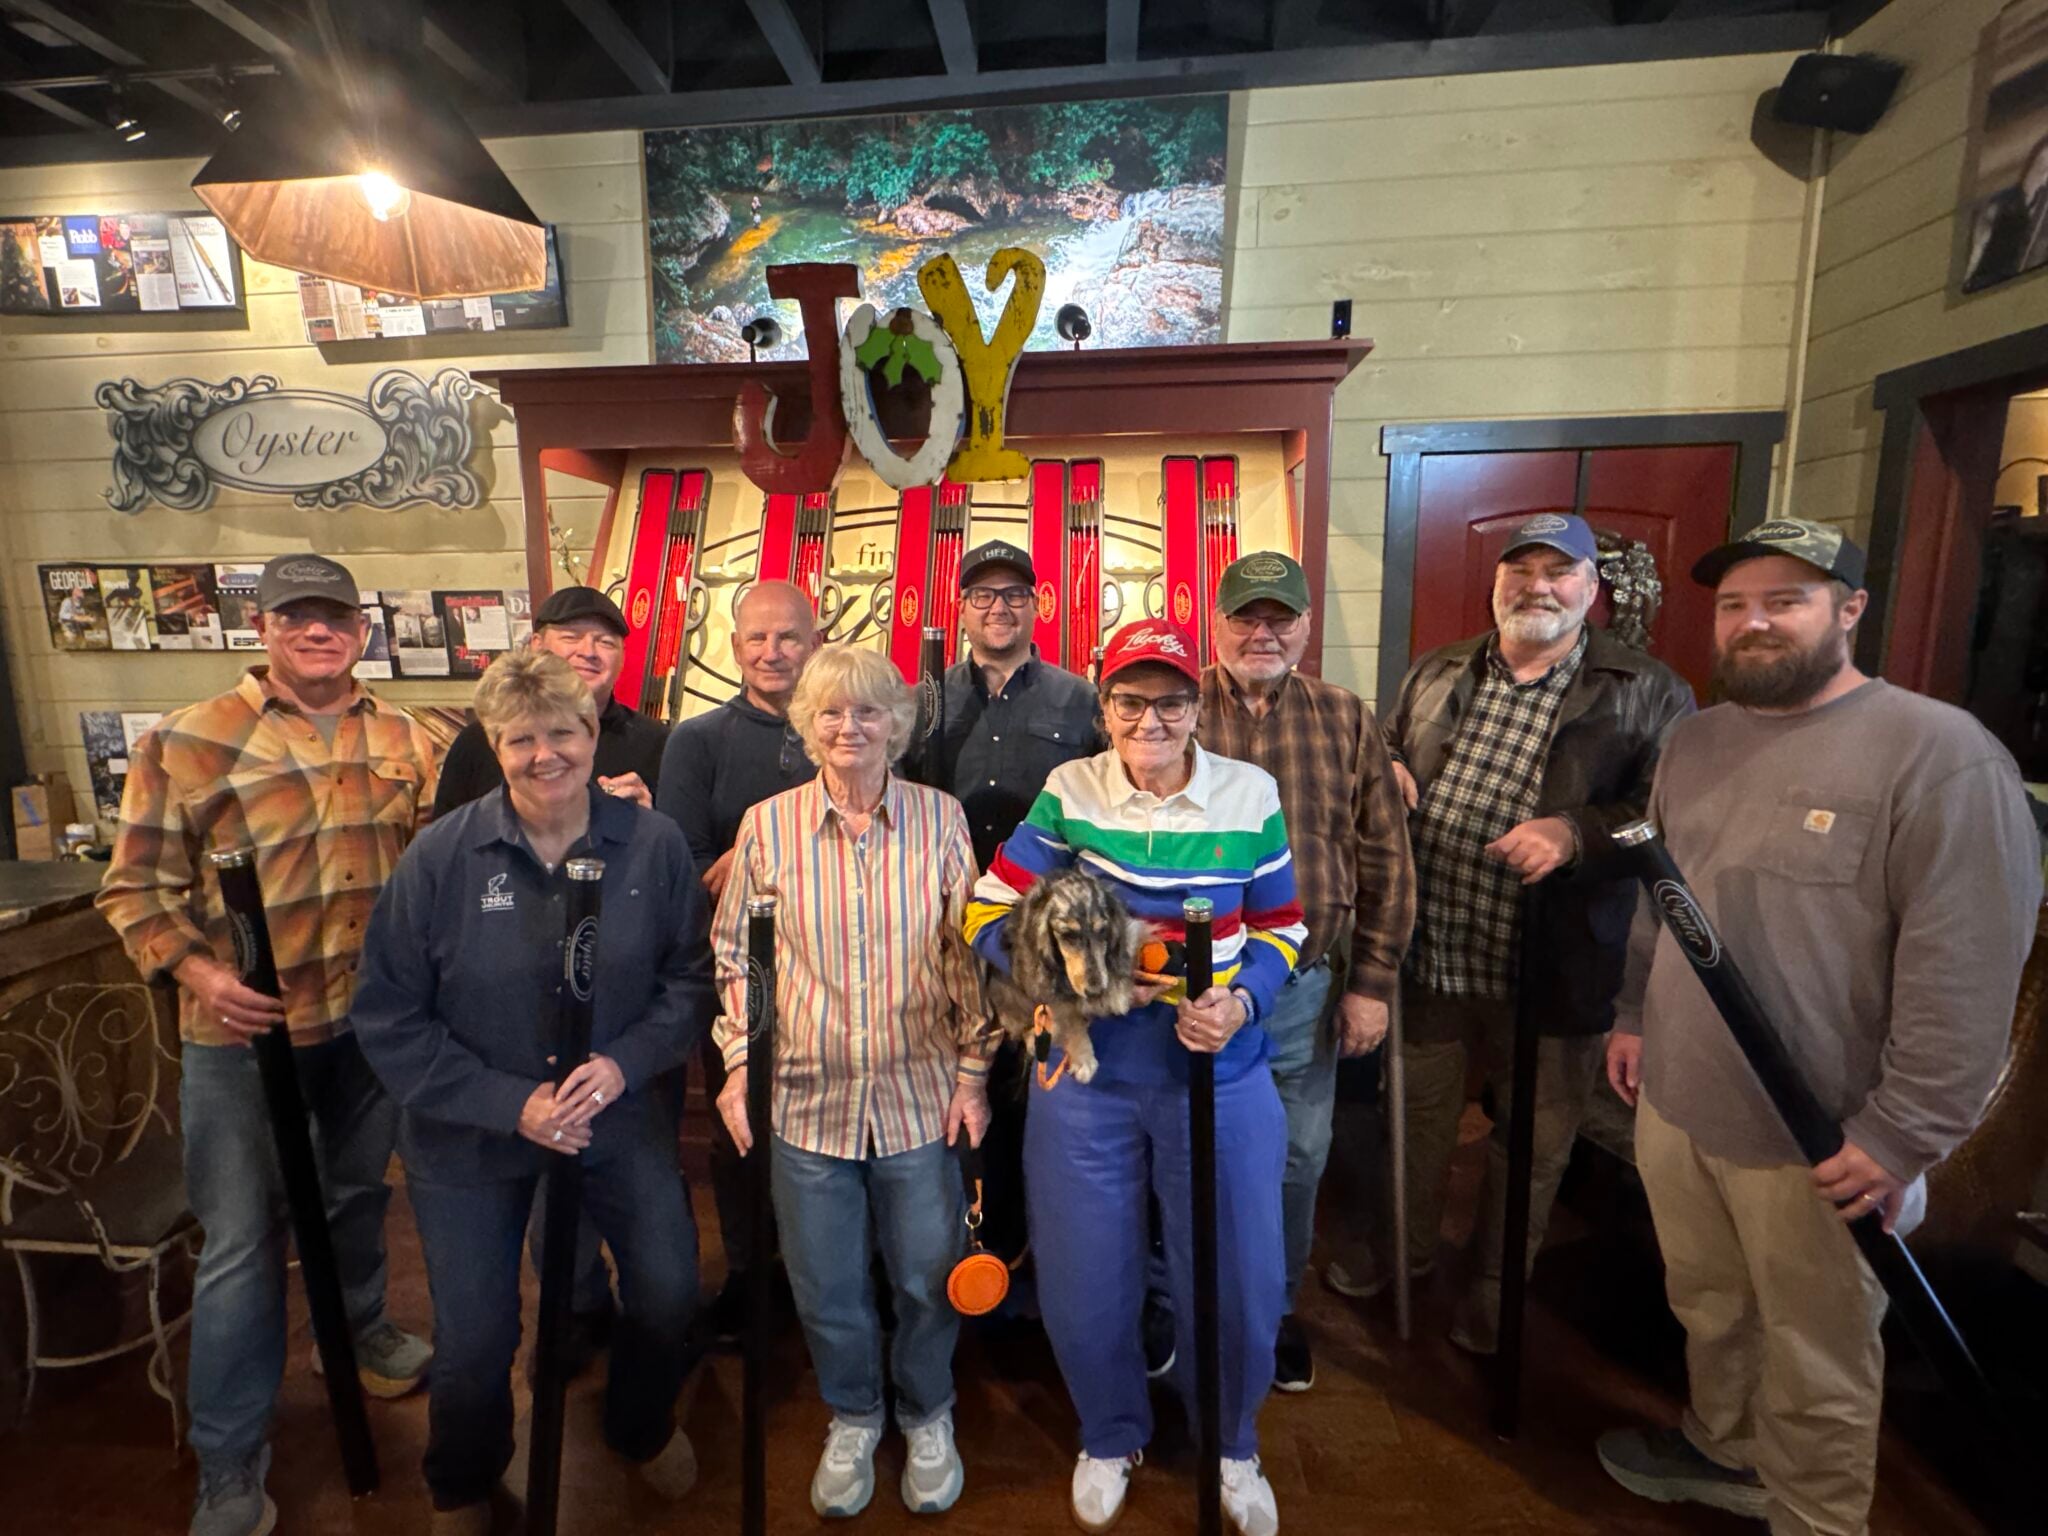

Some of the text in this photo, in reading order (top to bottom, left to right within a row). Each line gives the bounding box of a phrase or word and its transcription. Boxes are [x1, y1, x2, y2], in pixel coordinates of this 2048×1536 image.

[68, 229, 98, 243] Robb
[732, 247, 1047, 491] JOY
[222, 411, 360, 475] Oyster
[49, 570, 95, 590] GEORGIA
[233, 637, 265, 646] ESP
[480, 896, 514, 905] TROUT
